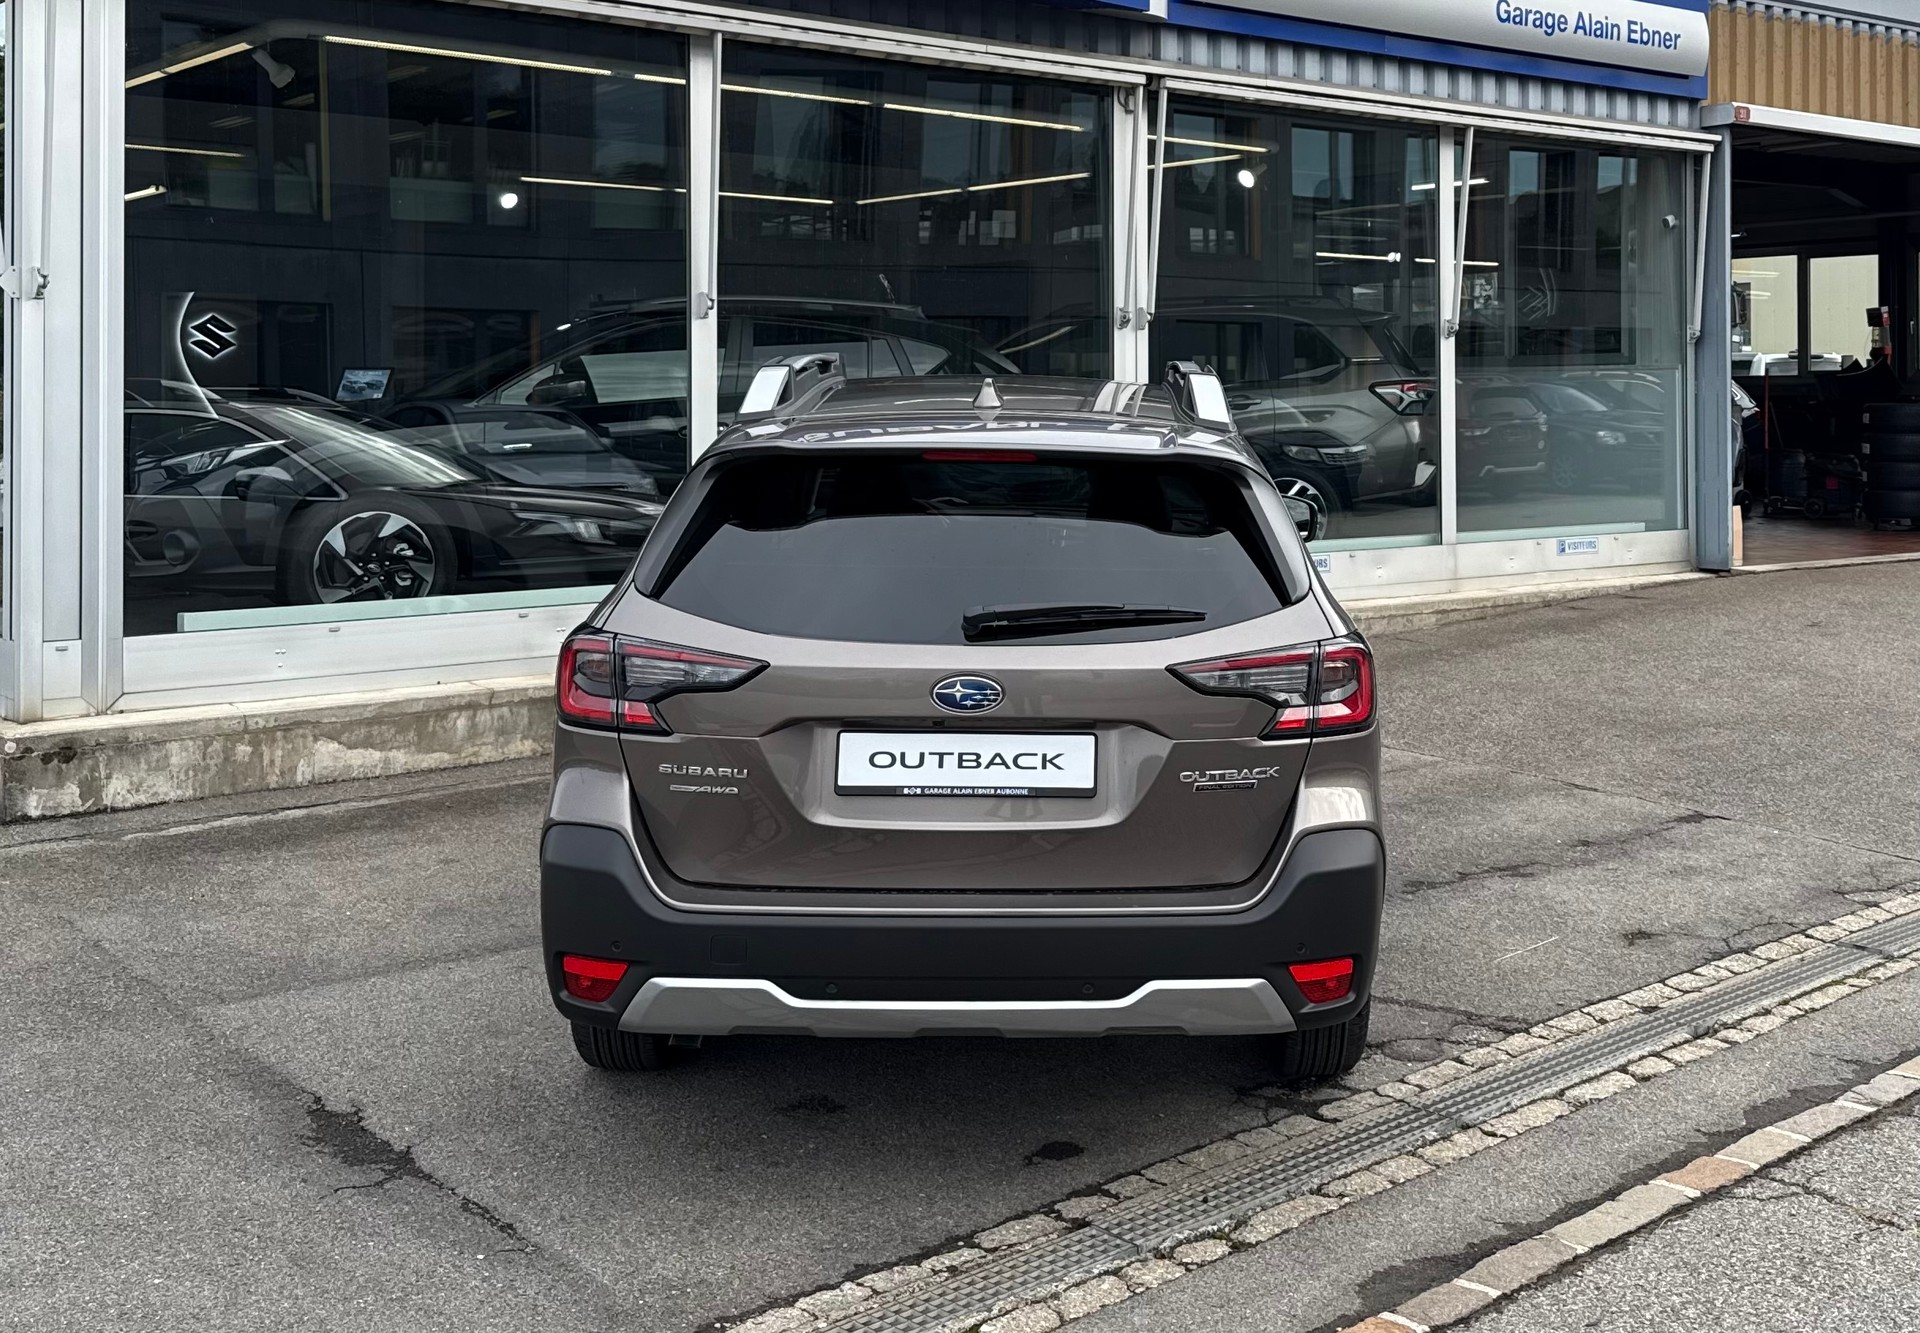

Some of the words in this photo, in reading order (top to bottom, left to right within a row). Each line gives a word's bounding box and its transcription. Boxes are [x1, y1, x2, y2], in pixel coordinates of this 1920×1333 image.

[1496, 0, 1568, 36] Garage
[1573, 11, 1621, 41] Alain
[1627, 19, 1681, 50] Ebner
[1567, 540, 1597, 551] VISITEURS
[868, 751, 1065, 770] OUTBACK
[658, 763, 748, 779] SUBARU
[1179, 766, 1280, 783] OUTBACK
[695, 786, 739, 794] AWD
